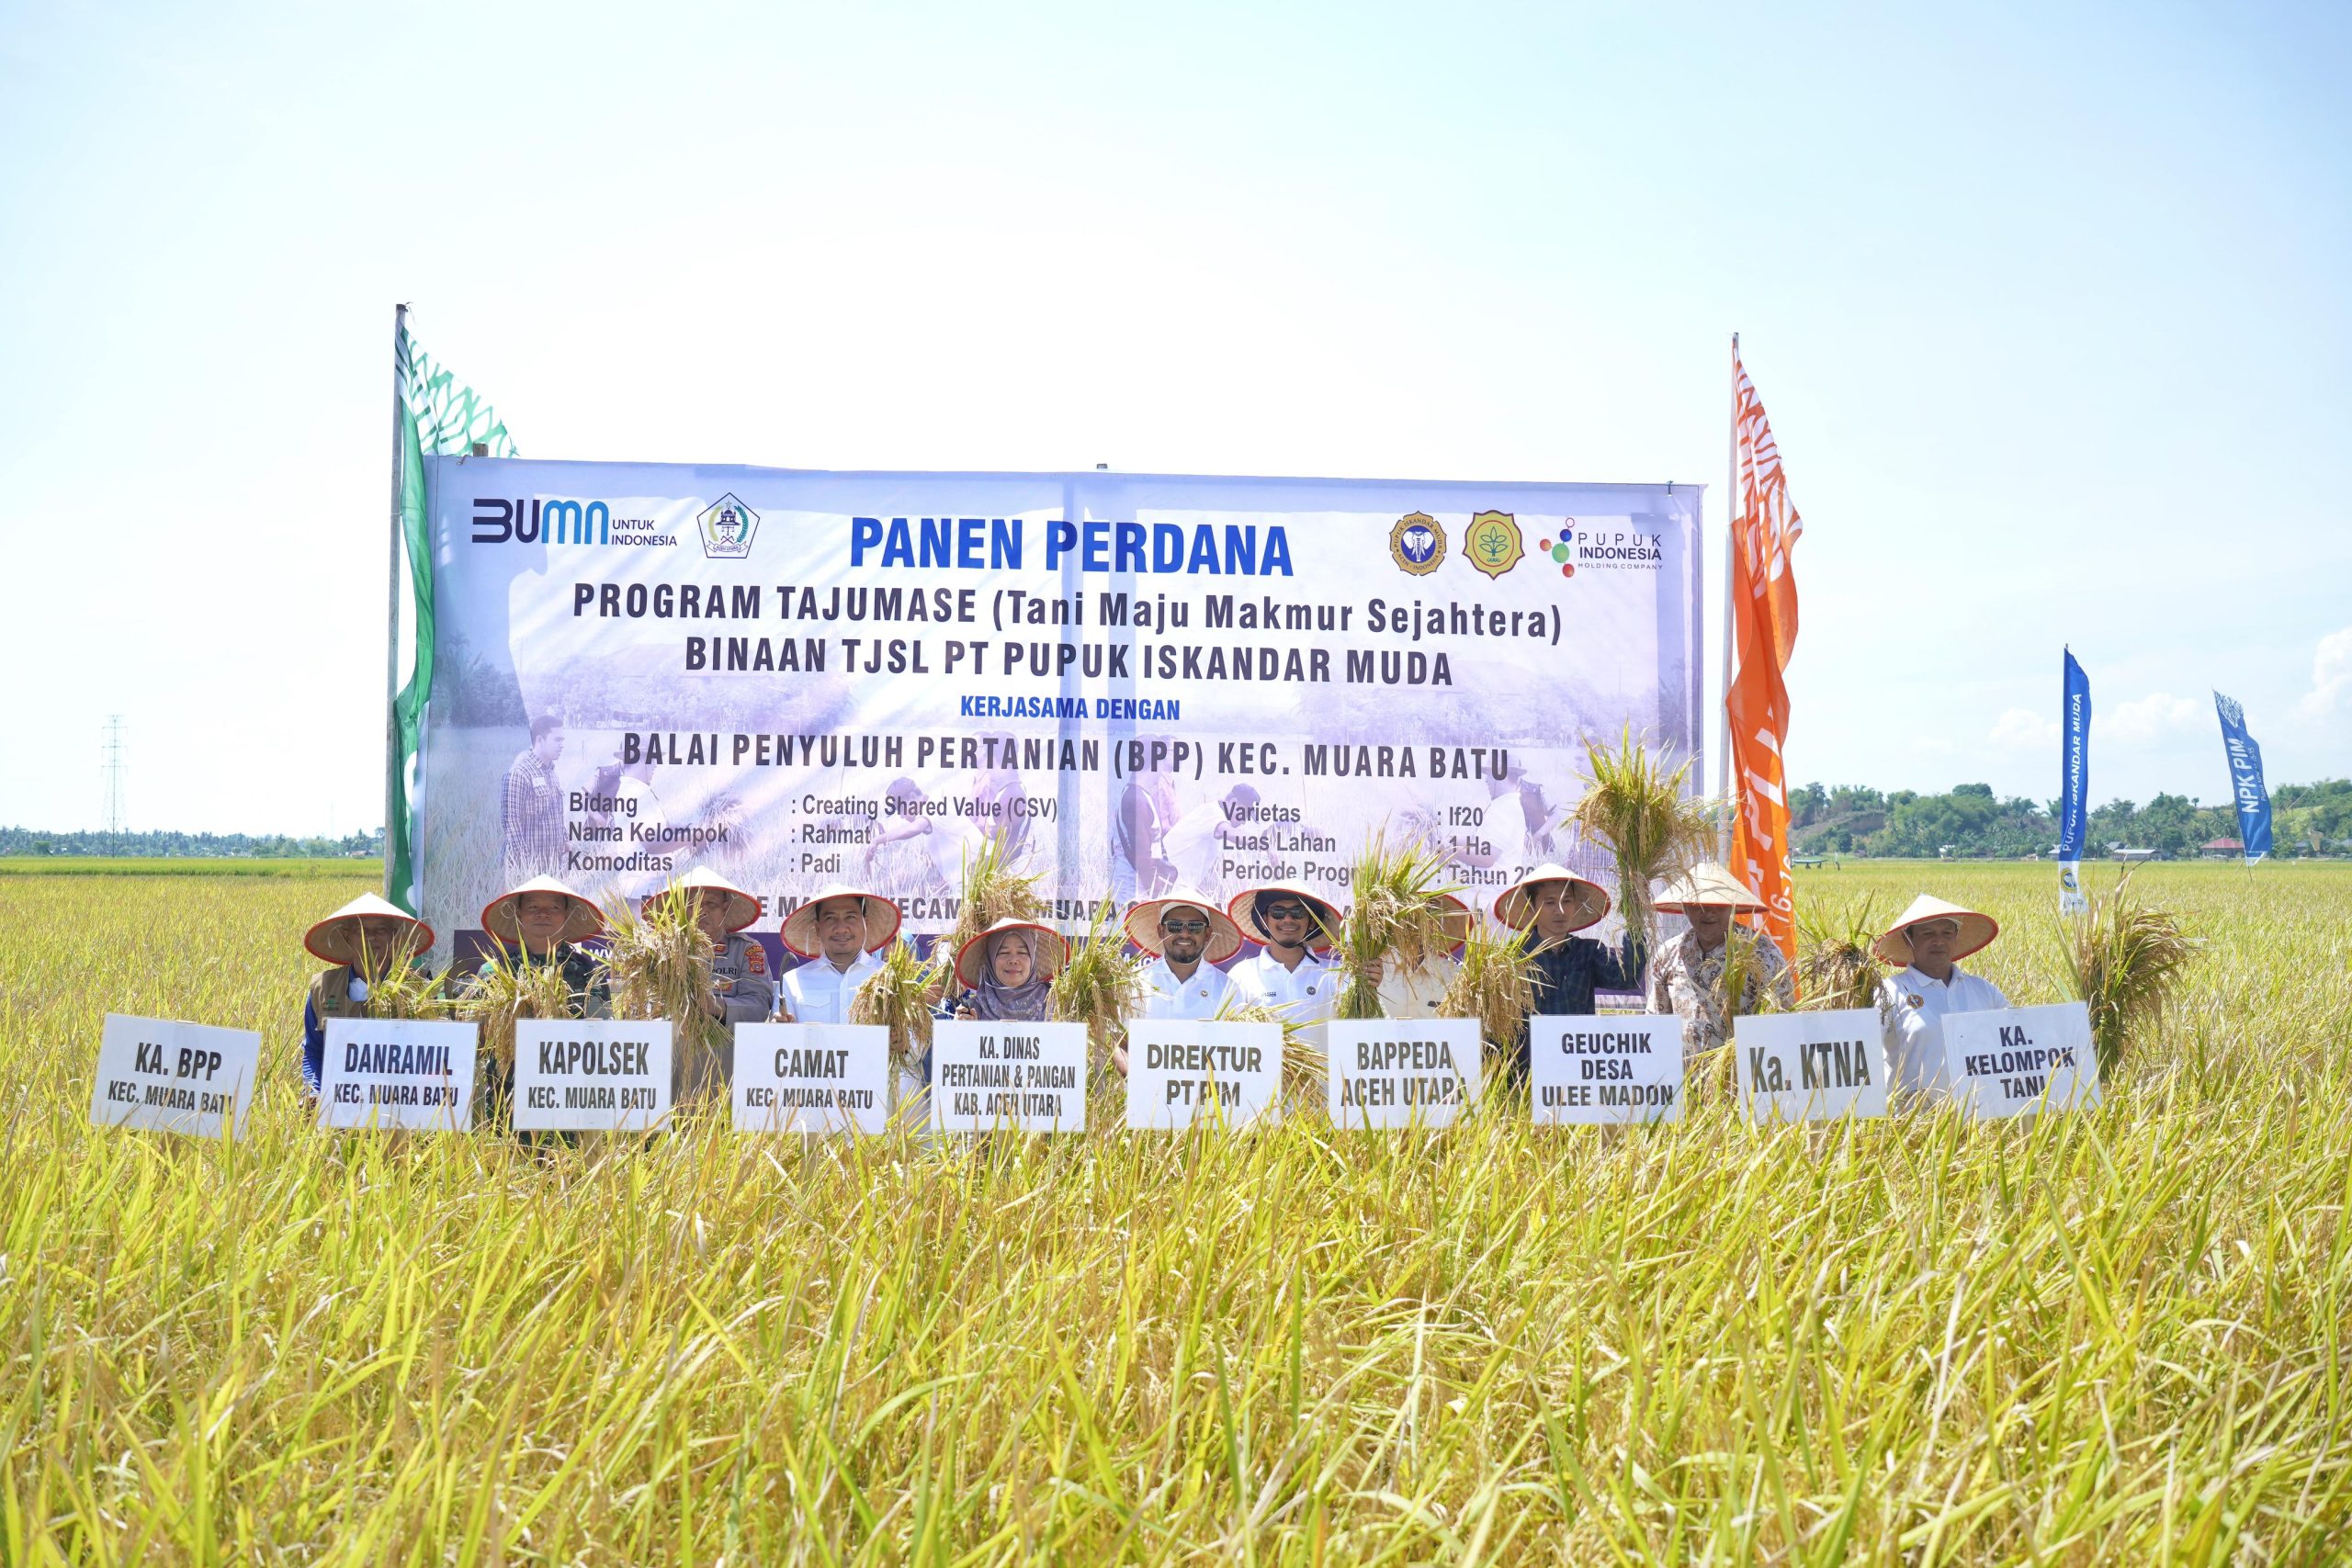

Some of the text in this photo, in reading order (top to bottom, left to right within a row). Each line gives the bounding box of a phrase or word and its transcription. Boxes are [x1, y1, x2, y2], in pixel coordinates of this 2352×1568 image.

[612, 519, 655, 531] UNTUK
[611, 535, 677, 546] INDONESIA
[850, 517, 1294, 576] PANEN PERDANA
[1577, 532, 1662, 547] PUPUK
[1578, 547, 1662, 560] INDONESIA
[573, 582, 1561, 646] PROGRAM TAJUMASE (Tani Maju Makmur Sejahtera)
[685, 637, 1453, 685] BINAAN TJSL PT PUPUK ISKANDAR MUDA
[960, 695, 1181, 720] KERJASAMA DENGAN
[2073, 693, 2083, 735] MUDA
[623, 732, 1509, 781] BALAI PENYULUH PERTANIAN (BPP) KEC. MUARA BATU
[2227, 737, 2261, 814] NPK PIM
[569, 792, 638, 818] Bidang
[802, 795, 878, 820] Creating
[884, 795, 947, 816] Shared
[953, 796, 1001, 816] Value
[1007, 796, 1057, 822] (CSV)
[1222, 801, 1301, 822] Varietas
[568, 821, 623, 841] Nama
[630, 822, 729, 847] Kelompok
[801, 824, 871, 844] Rahmat
[1222, 830, 1270, 851] Luas
[1277, 831, 1336, 852] Lahan
[1449, 836, 1456, 854] 1
[1465, 836, 1491, 855] Ha
[568, 852, 673, 872] Komoditas
[801, 852, 841, 873] Padi
[1222, 859, 1297, 880] Periode
[1303, 861, 1359, 886] Prog
[1448, 864, 1508, 886] Tahun
[979, 1035, 1040, 1060] KA. DINAS
[1561, 1032, 1652, 1055] GEUCHIK
[1999, 1025, 2033, 1047] KA.
[135, 1042, 222, 1081] KA. BPP
[345, 1043, 453, 1076] DANRAMIL
[538, 1041, 649, 1075] KAPOLSEK
[775, 1048, 849, 1078] CAMAT
[1147, 1043, 1261, 1073] DIREKTUR
[1357, 1042, 1452, 1070] BAPPEDA
[1749, 1040, 1871, 1093] Ka. KTNA
[1964, 1046, 2075, 1077] KELOMPOK
[942, 1064, 1076, 1089] PERTANIAN & PANGAN
[1581, 1059, 1634, 1080] DESA
[107, 1080, 139, 1102] KEC.
[144, 1085, 195, 1111] MUARA
[334, 1083, 458, 1107] KEC. MUARA BATU
[528, 1087, 656, 1110] KEC. MUARA BATU
[746, 1088, 873, 1109] KEC MUARA BATU
[1166, 1079, 1194, 1105] PT
[1340, 1077, 1395, 1107] ACEH
[1542, 1085, 1673, 1107] ULEE MADON
[2000, 1075, 2046, 1100] TANI
[954, 1092, 1062, 1116] KAB. ACEH UTARA
